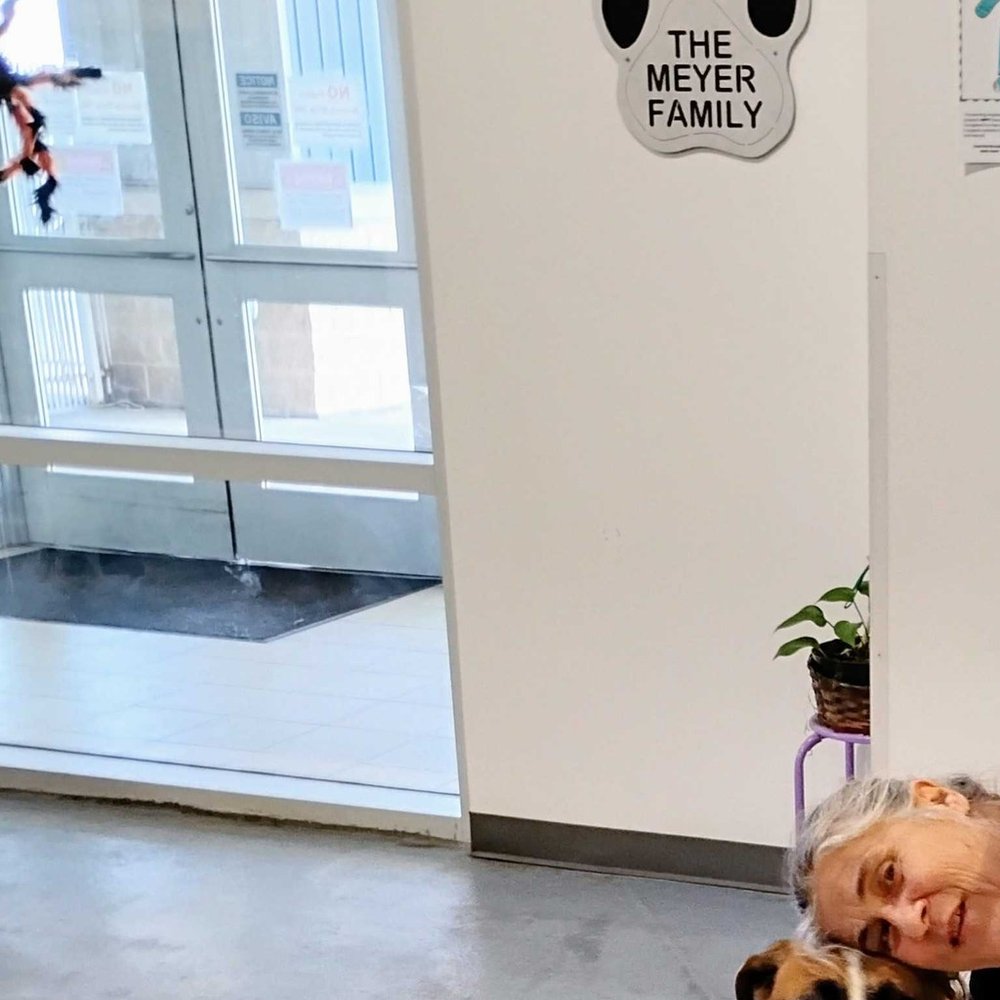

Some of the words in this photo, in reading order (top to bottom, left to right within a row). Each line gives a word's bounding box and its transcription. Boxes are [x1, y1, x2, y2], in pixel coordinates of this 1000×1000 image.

[668, 30, 732, 58] THE
[647, 64, 756, 93] MEYER
[648, 99, 762, 129] FAMILY
